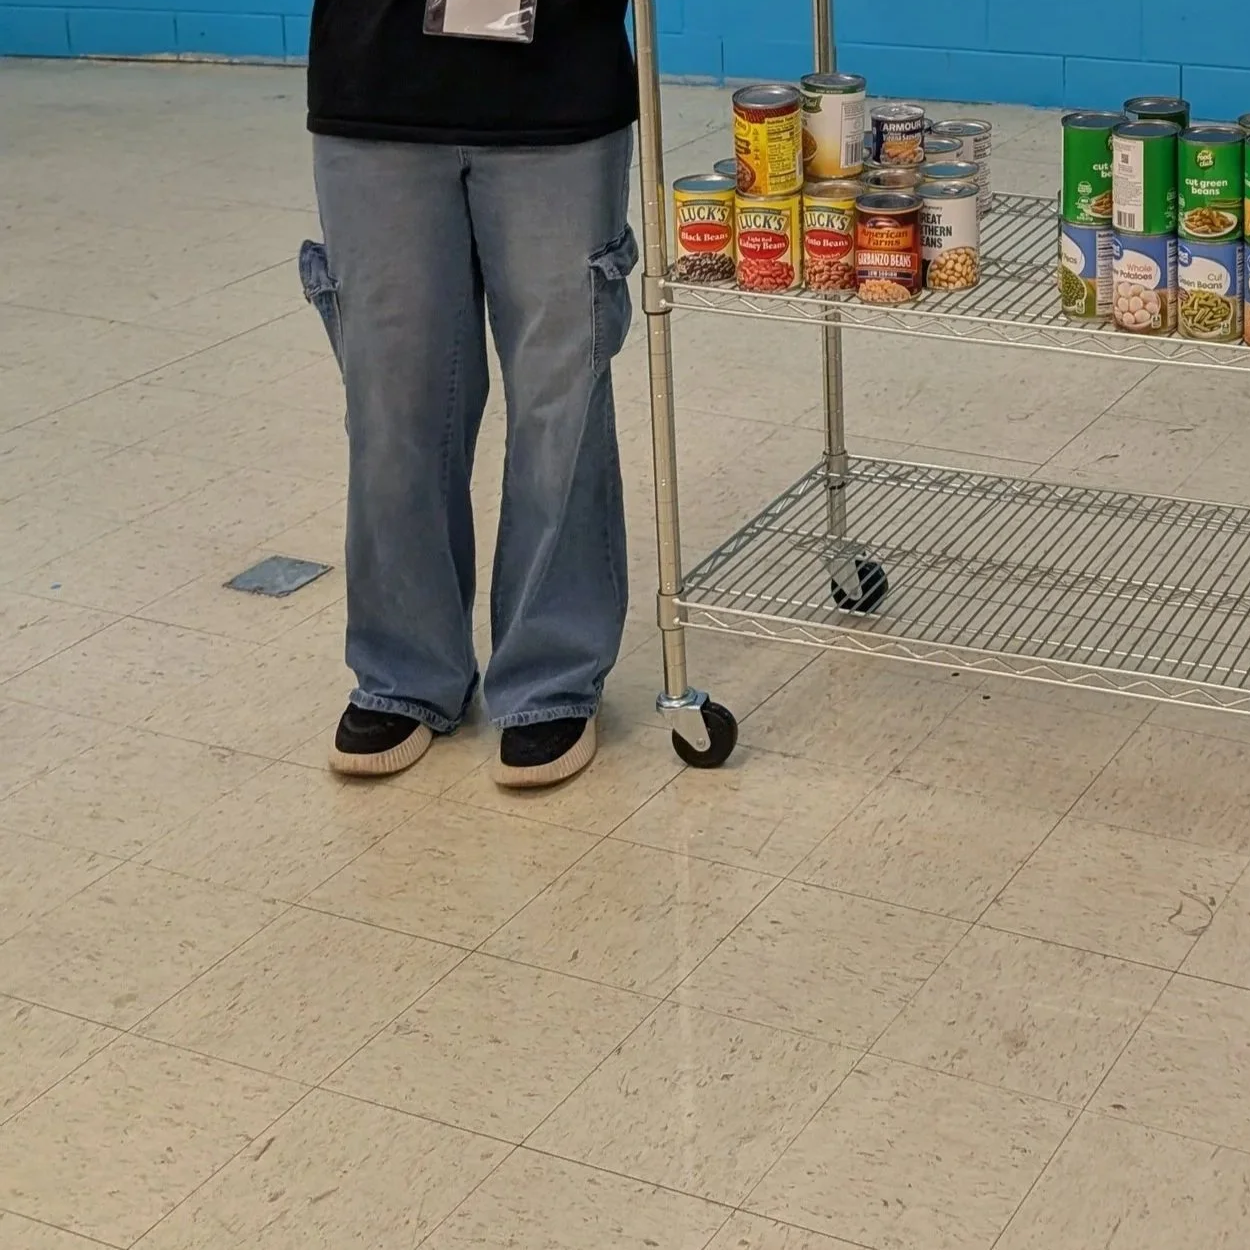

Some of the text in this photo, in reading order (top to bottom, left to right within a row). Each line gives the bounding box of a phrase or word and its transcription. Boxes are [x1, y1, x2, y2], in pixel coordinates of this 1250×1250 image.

[882, 120, 921, 131] ARMOUR
[1092, 163, 1109, 171] cut
[1185, 178, 1228, 189] cut green
[1191, 186, 1220, 195] beans
[681, 206, 729, 223] LUCK'S
[920, 213, 942, 225] REAT
[739, 214, 785, 230] LUCK'S
[804, 212, 848, 230] LUCK'S
[681, 231, 729, 242] Black Beans
[861, 228, 909, 239] American
[762, 240, 786, 250] Beans
[822, 238, 848, 247] Beans
[867, 238, 902, 247] Farms
[858, 253, 912, 267] GARBANZO BEANS
[1126, 263, 1153, 272] Whole
[1119, 271, 1153, 280] Potatoes
[1207, 273, 1223, 281] Cut
[1196, 281, 1223, 290] Beans
